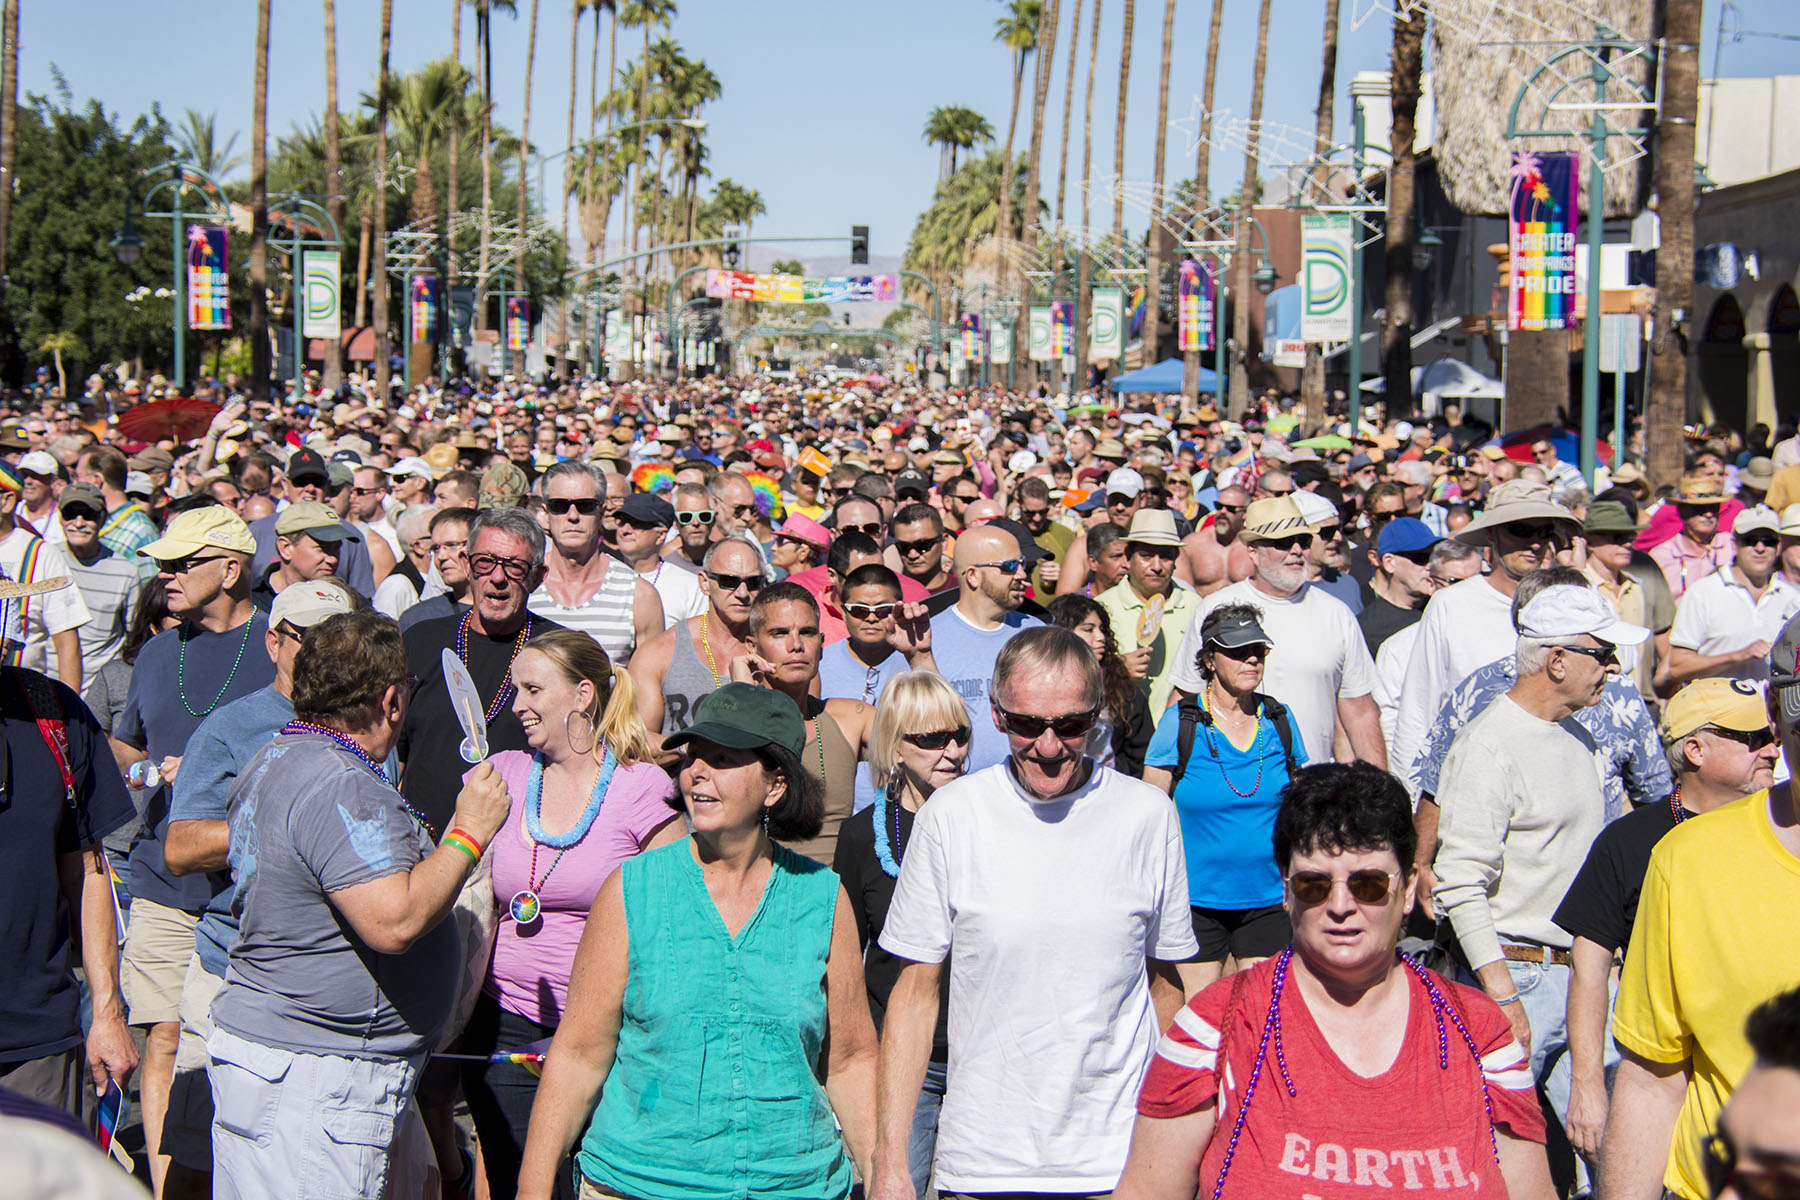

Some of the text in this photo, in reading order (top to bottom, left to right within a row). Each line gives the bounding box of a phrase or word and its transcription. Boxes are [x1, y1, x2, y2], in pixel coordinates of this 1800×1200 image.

[1512, 232, 1575, 251] GREATER
[1512, 275, 1575, 294] PRIDE
[1278, 1132, 1480, 1192] EARTH,
